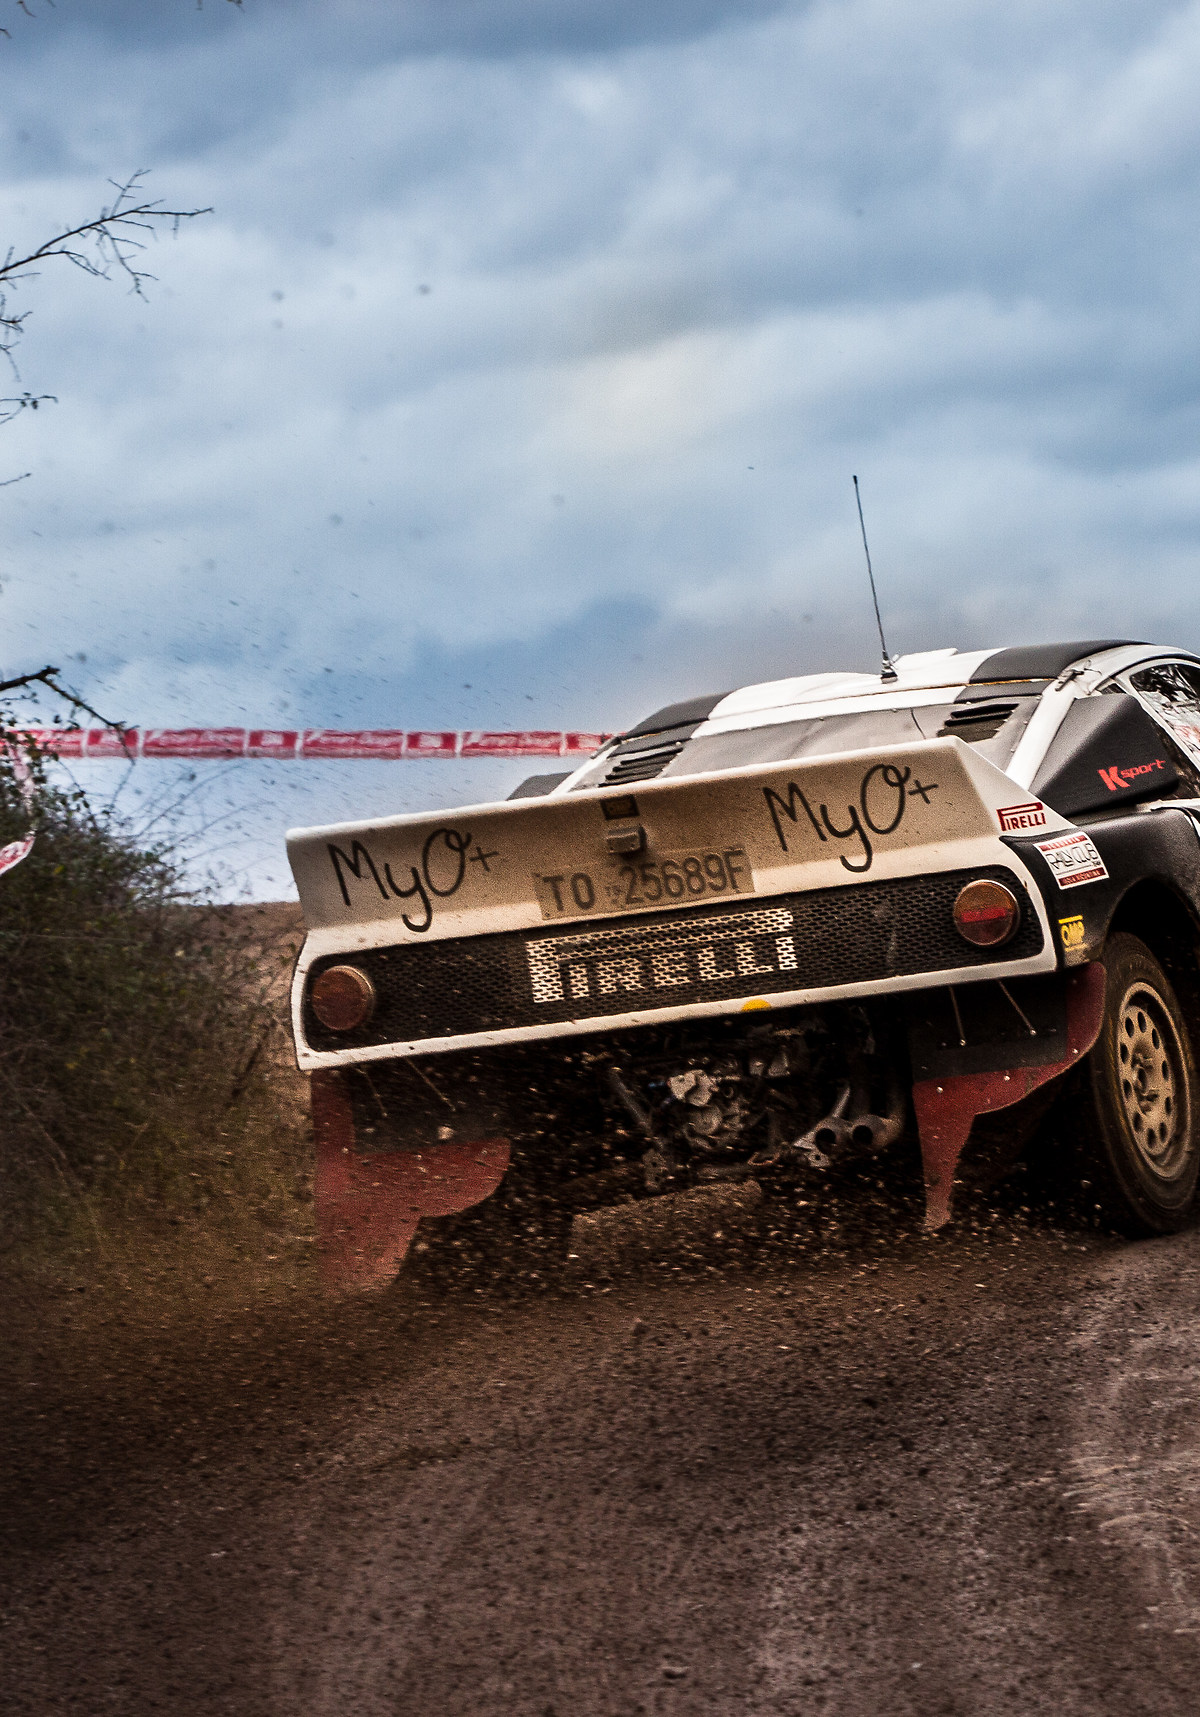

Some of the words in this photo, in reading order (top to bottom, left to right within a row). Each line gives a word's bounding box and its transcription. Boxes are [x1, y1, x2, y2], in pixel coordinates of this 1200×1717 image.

[996, 802, 1047, 832] PIRELLI
[543, 872, 597, 911] TO
[619, 848, 745, 904] 25689F
[525, 907, 799, 1003] PIRELLI
